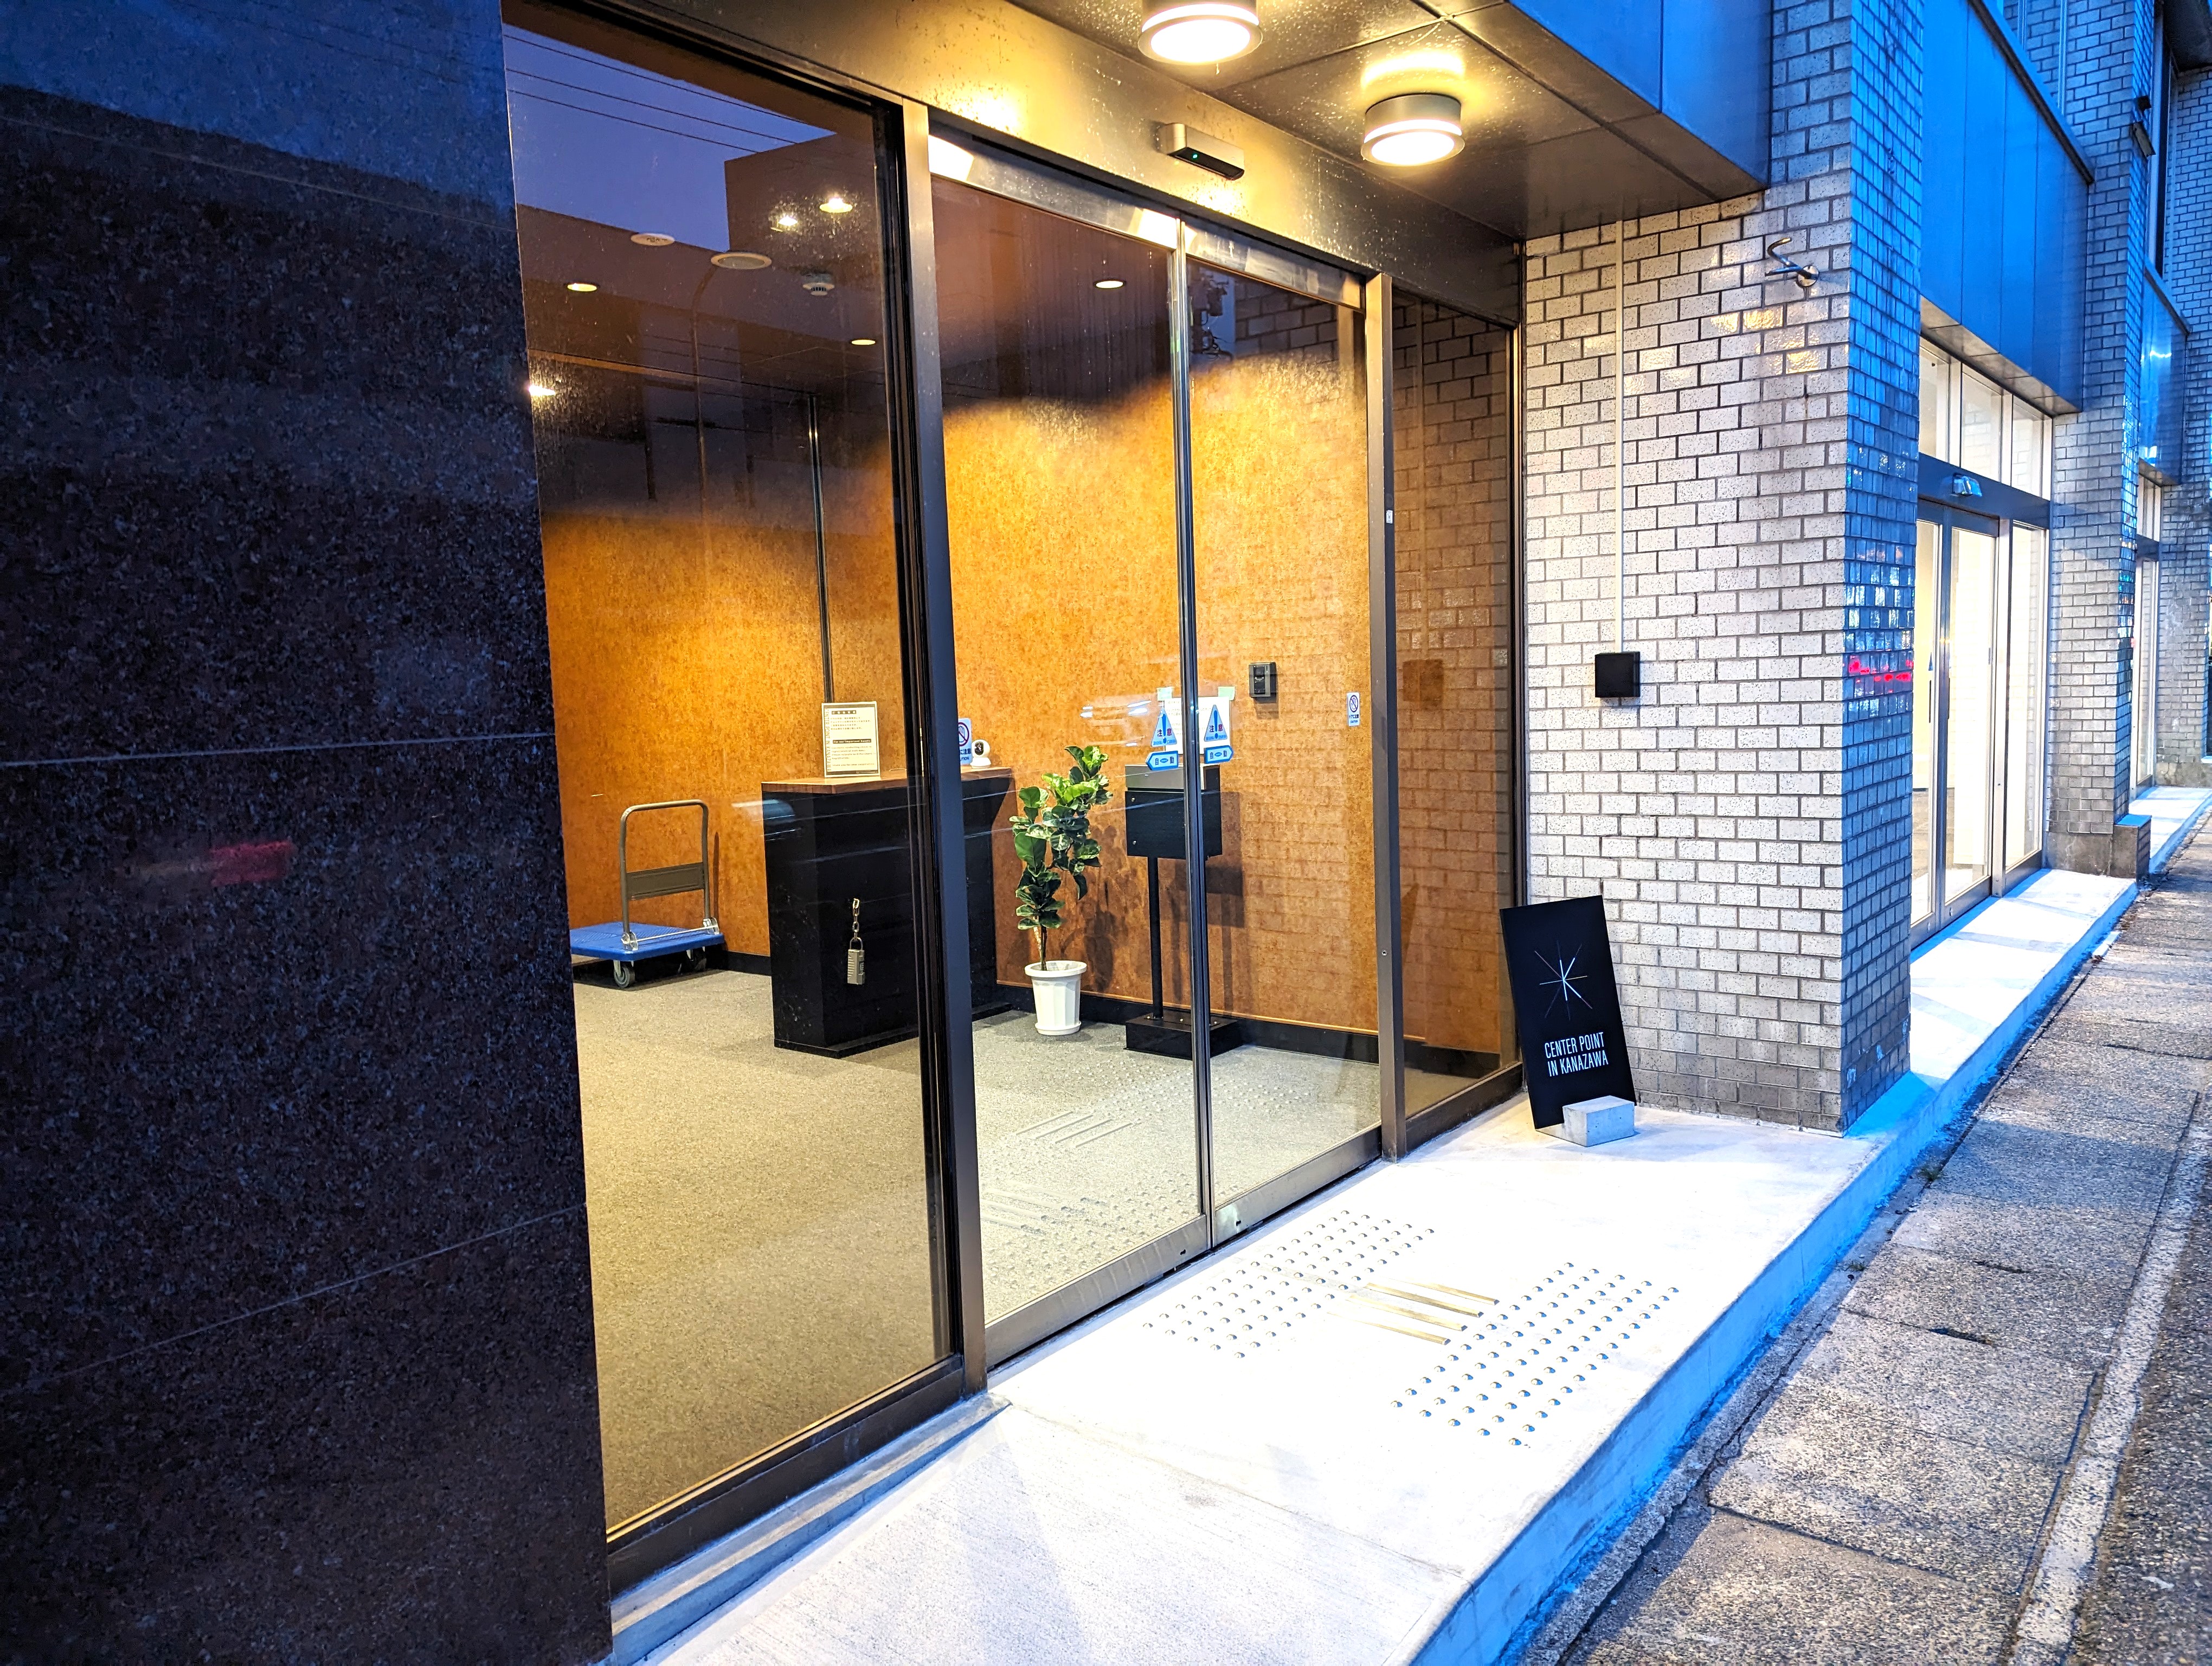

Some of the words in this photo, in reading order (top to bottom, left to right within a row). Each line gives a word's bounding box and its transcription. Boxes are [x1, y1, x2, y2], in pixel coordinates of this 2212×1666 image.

[1545, 1038, 1578, 1058] CENTER
[1579, 1032, 1604, 1051] POINT
[1548, 1060, 1558, 1077] IN
[1560, 1050, 1609, 1074] KANAZAWA
